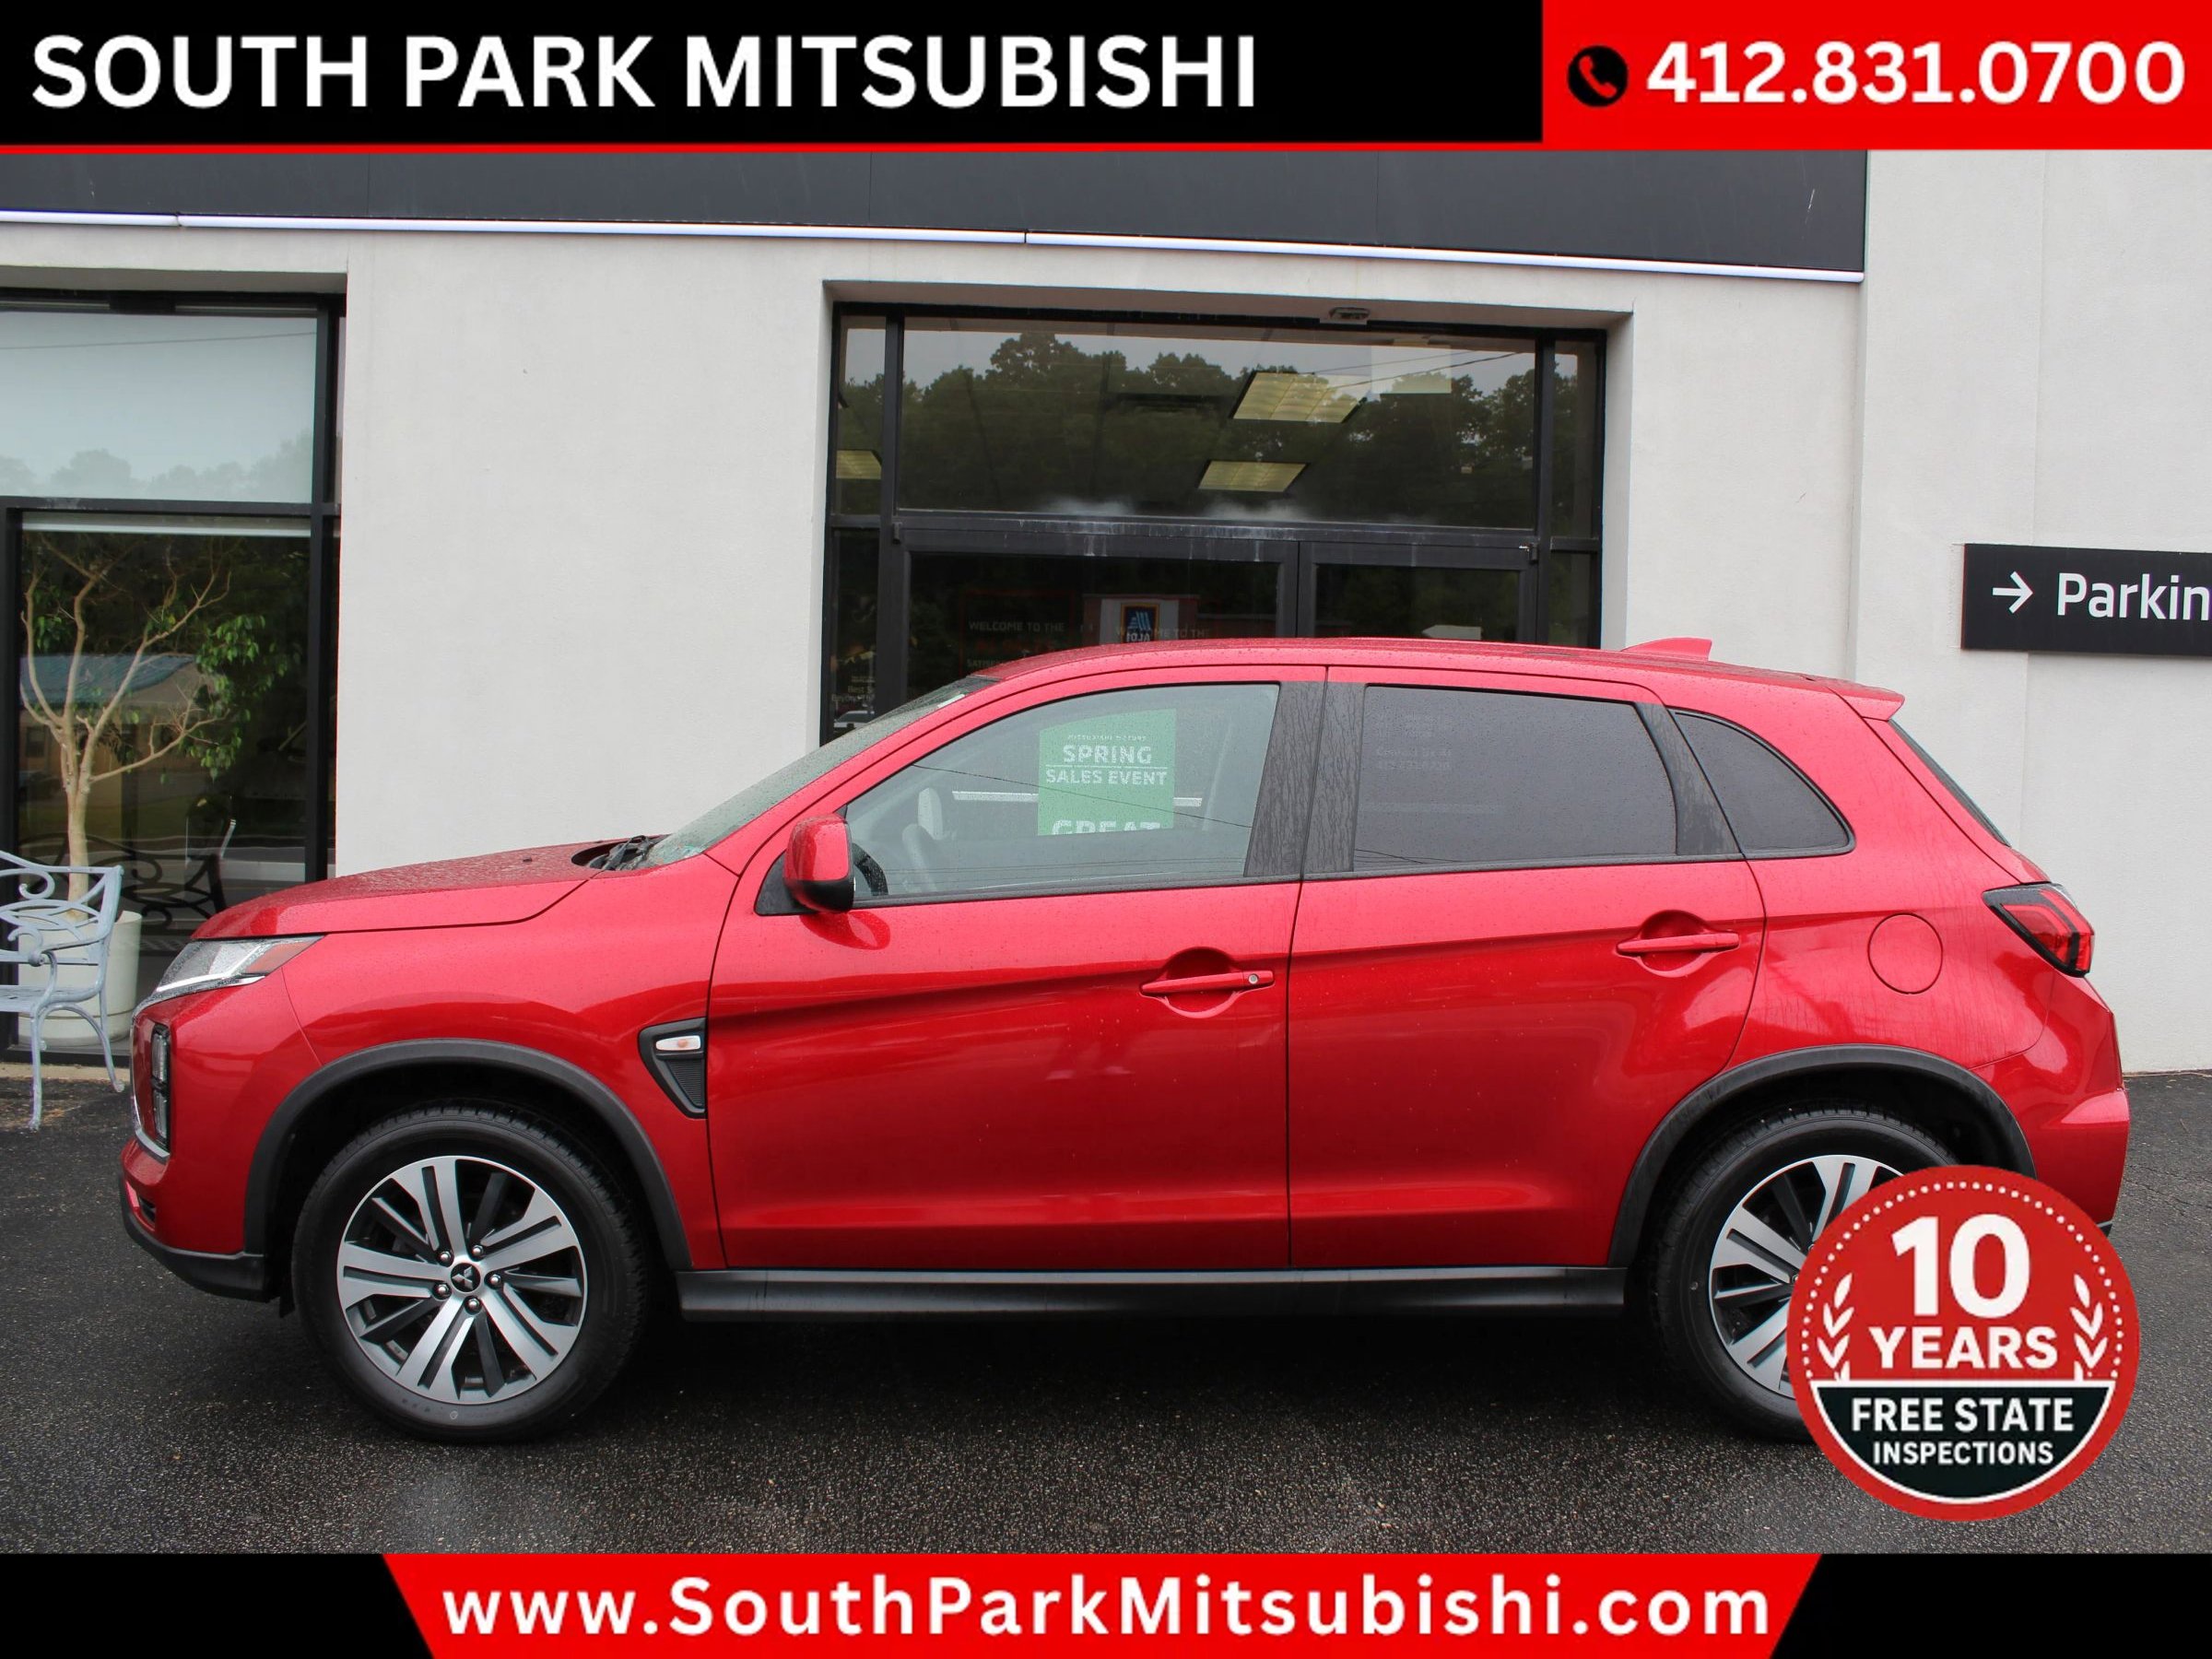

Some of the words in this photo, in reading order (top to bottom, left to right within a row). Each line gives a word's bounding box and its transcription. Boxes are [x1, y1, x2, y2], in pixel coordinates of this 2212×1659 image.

[2057, 572, 2212, 621] Parkin
[969, 621, 1023, 632] WELCOME
[1026, 622, 1041, 632] TO
[1044, 622, 1065, 632] THE
[1063, 745, 1152, 764] SPRING
[1046, 769, 1102, 783] SALES
[1108, 771, 1168, 785] EVENT
